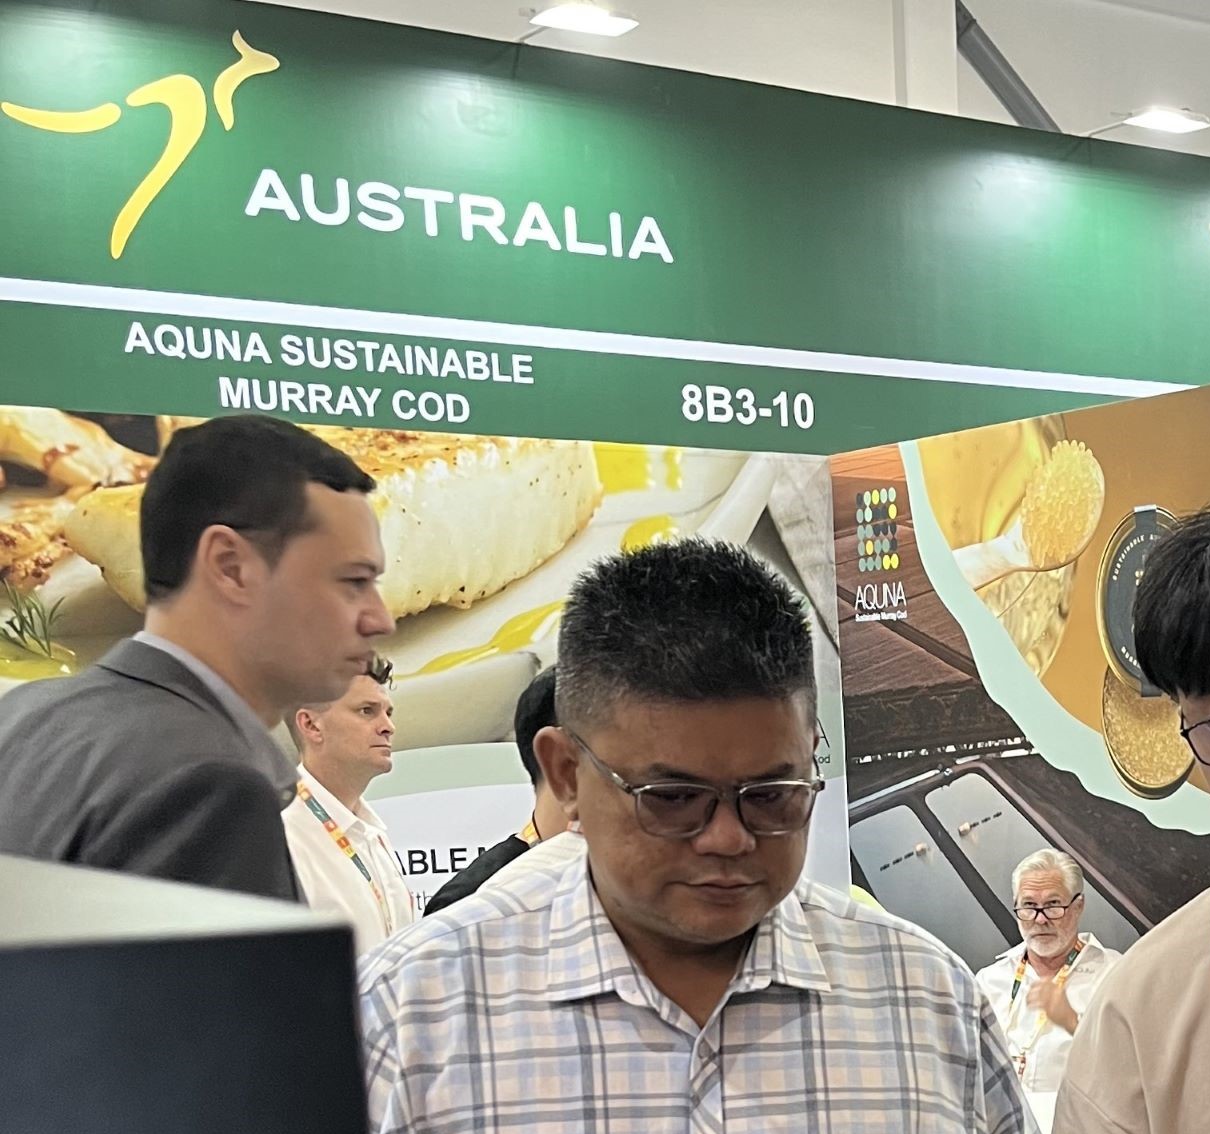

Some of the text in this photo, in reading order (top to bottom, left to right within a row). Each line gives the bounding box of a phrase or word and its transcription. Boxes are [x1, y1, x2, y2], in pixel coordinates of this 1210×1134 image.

[244, 168, 675, 264] AUSTRALIA
[124, 321, 535, 385] AQUNA SUSTAINABLE
[218, 376, 471, 424] MURRAY COD
[681, 383, 815, 430] 8B3-10
[855, 581, 907, 610] AQUNA
